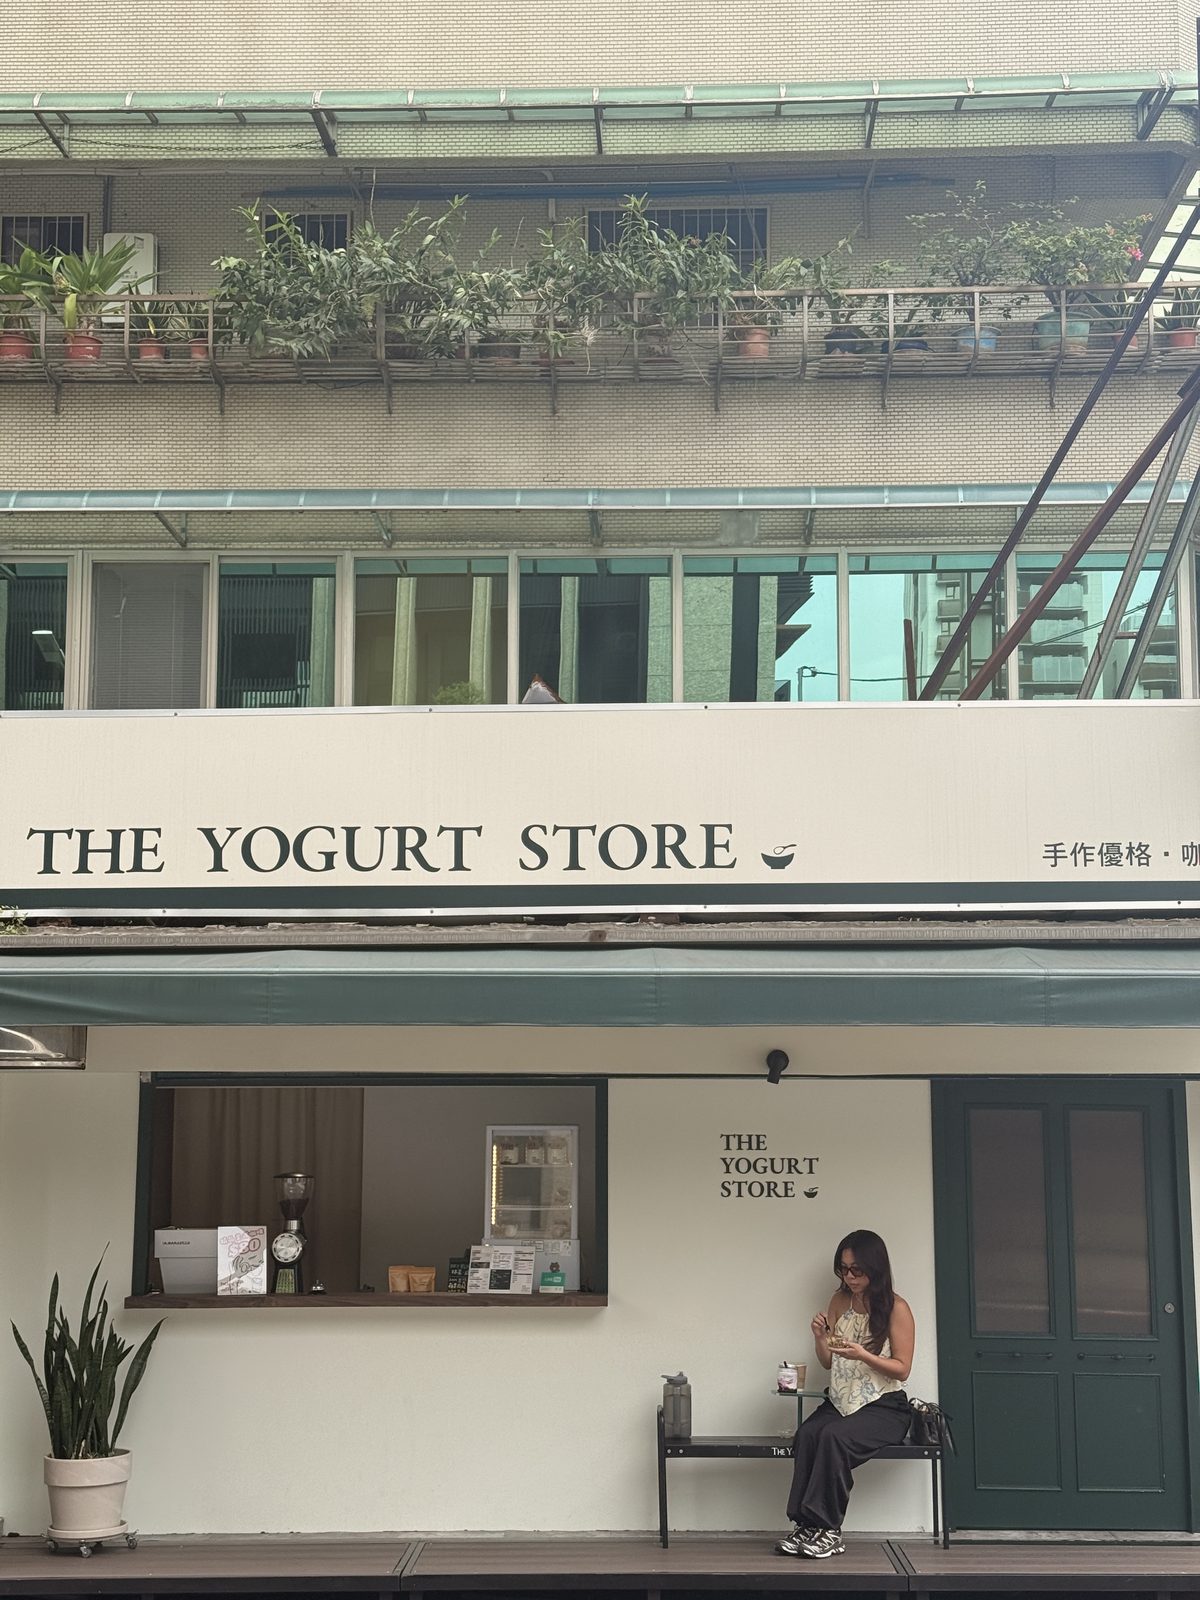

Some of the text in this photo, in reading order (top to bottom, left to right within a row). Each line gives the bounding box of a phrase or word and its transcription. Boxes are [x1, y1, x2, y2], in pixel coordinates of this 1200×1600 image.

[27, 823, 737, 875] THE YOGURT STORE
[719, 1133, 768, 1151] THE
[719, 1157, 820, 1175] YOGURT
[720, 1180, 796, 1198] STORE
